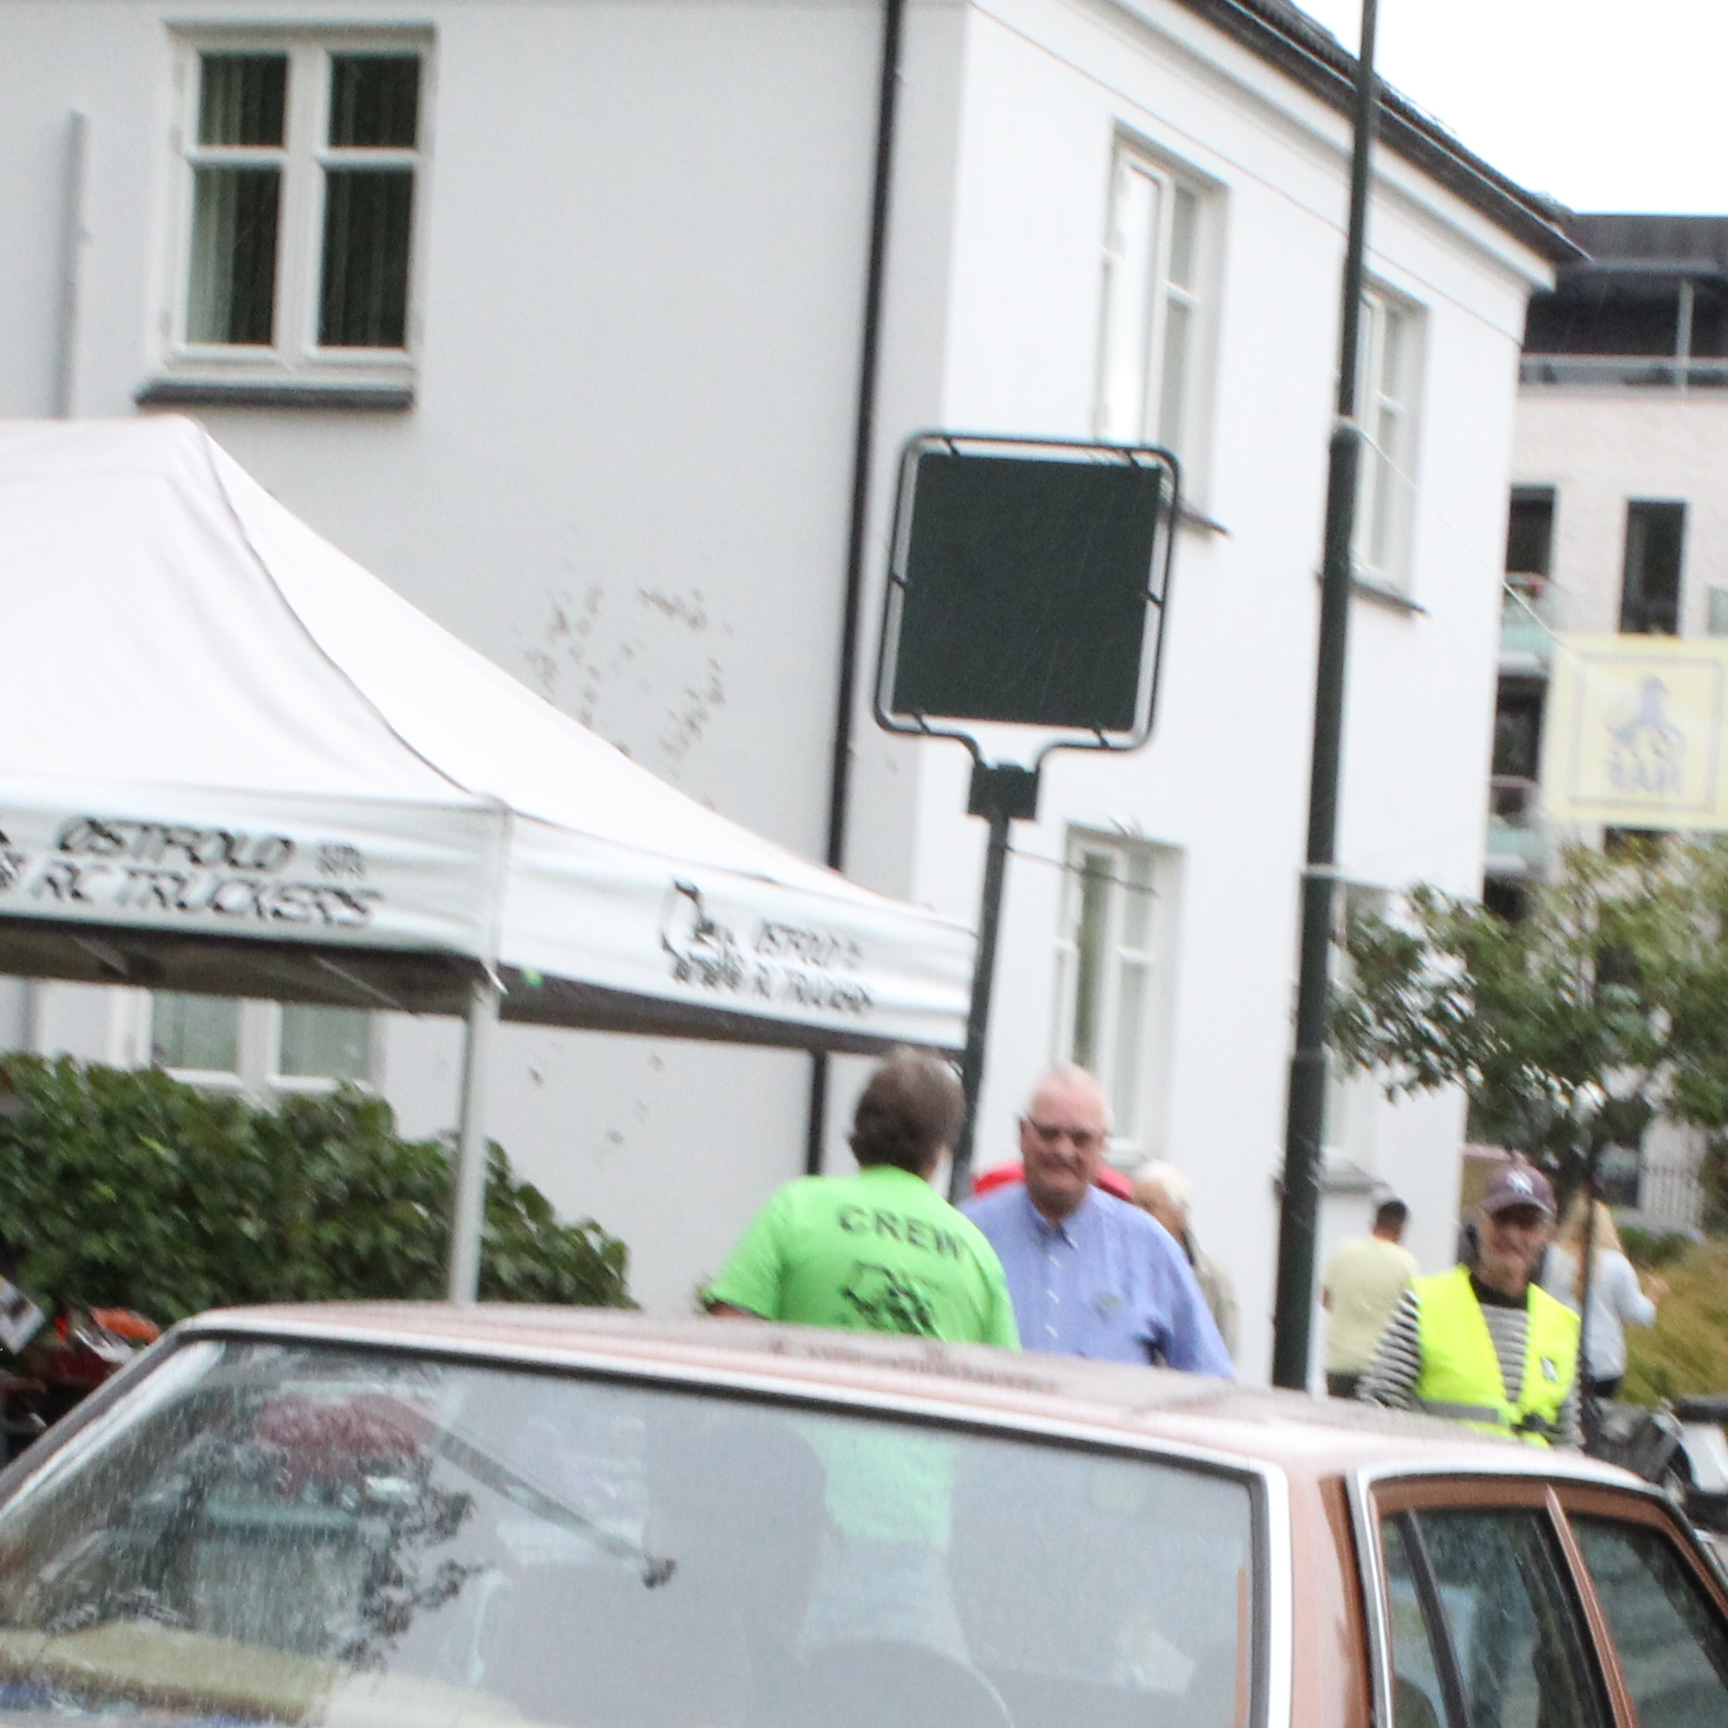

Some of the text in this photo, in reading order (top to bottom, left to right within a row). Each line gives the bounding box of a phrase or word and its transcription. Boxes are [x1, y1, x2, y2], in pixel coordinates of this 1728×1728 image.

[32, 860, 385, 931] RC TRUCKERS
[838, 1203, 968, 1263] CREW
